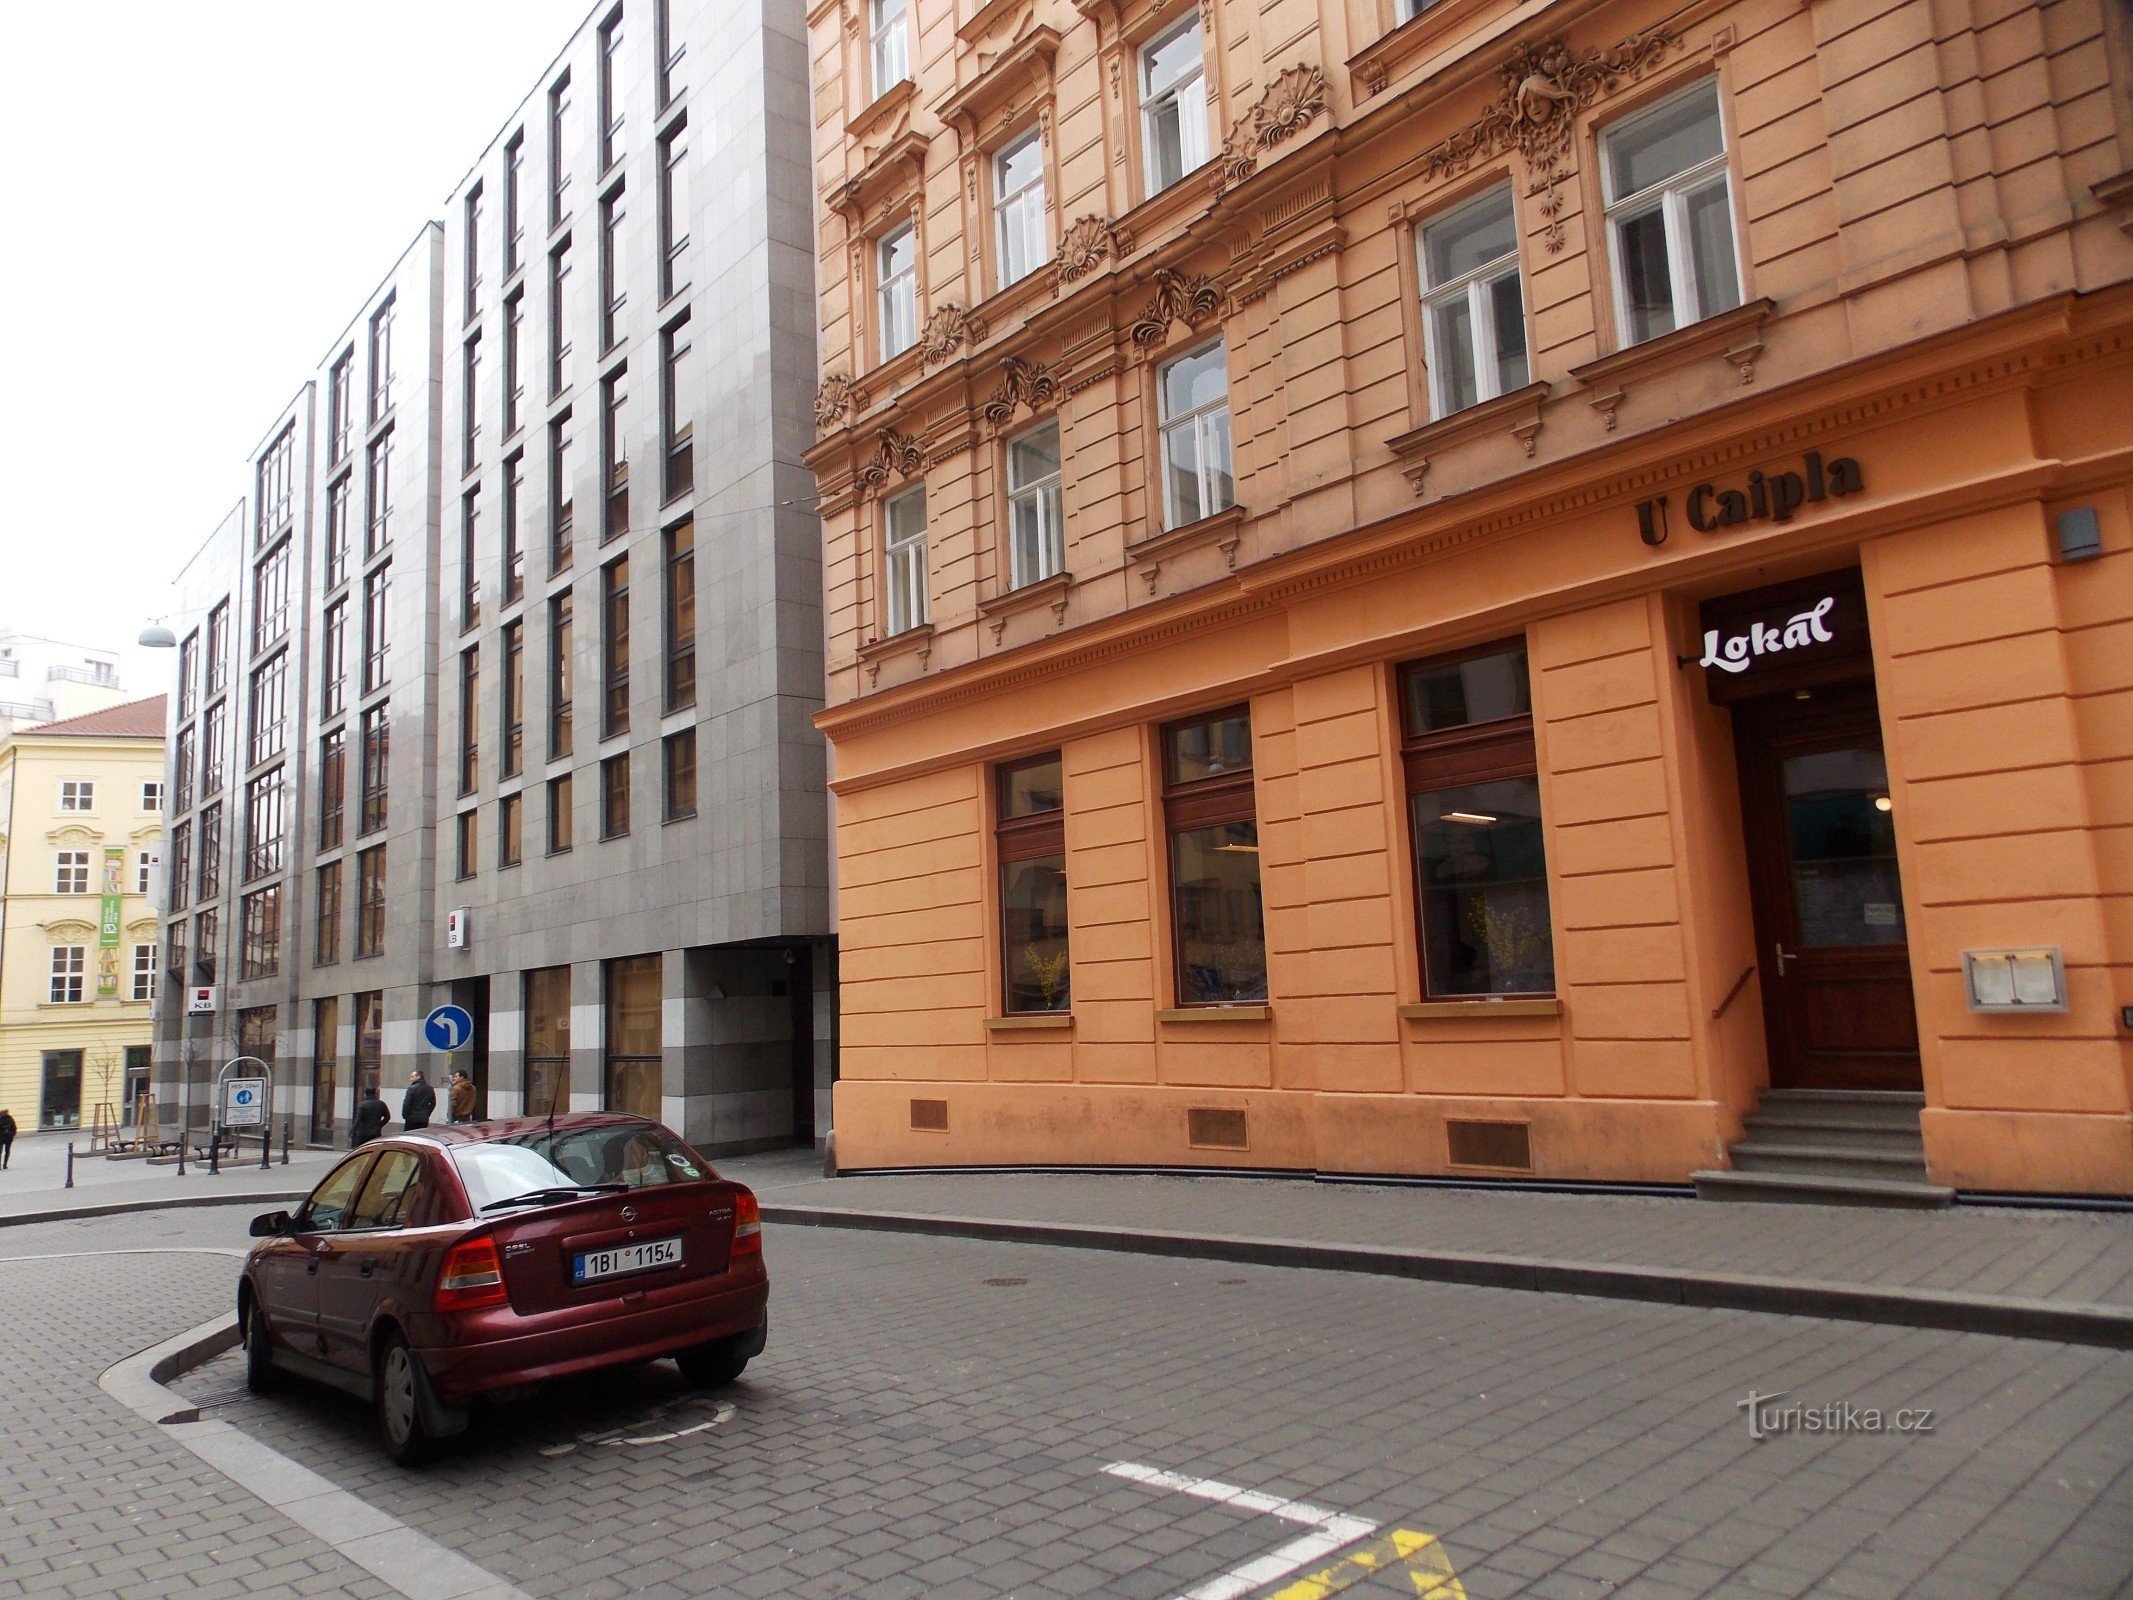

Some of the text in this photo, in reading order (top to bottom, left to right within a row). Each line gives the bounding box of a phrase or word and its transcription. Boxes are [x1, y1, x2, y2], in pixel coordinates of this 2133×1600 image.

[1635, 450, 1865, 546] U Caipla
[505, 1243, 531, 1252] OPEL
[590, 1242, 674, 1274] 1BI 1154
[575, 1270, 585, 1278] CZ
